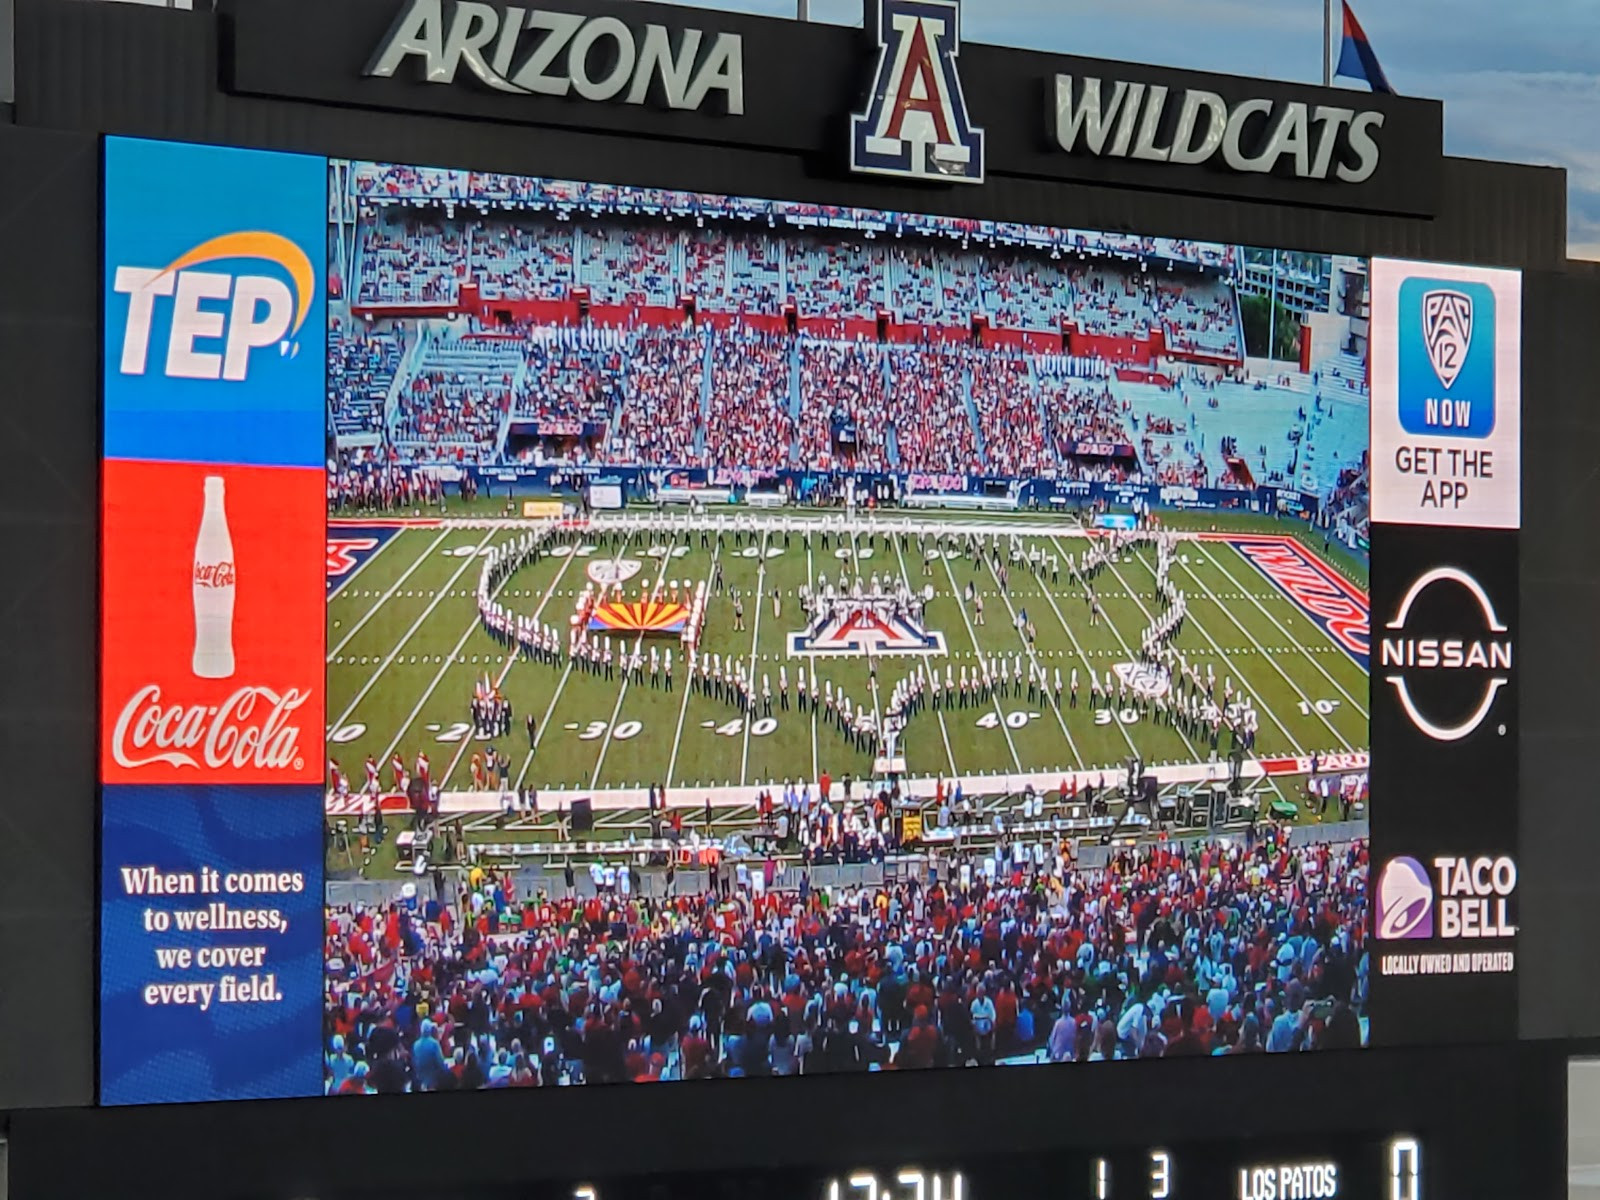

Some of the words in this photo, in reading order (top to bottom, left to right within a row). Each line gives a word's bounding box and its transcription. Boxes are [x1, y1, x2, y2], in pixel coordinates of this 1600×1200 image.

[360, 0, 745, 116] ARIZONA
[850, 0, 985, 184] A
[1055, 74, 1385, 183] WILDCATS
[114, 265, 293, 382] TEP
[1425, 293, 1472, 346] PAC
[1438, 342, 1457, 369] 12
[1426, 398, 1471, 428] NOW
[1395, 446, 1443, 475] GET
[1447, 449, 1493, 479] THE
[1420, 479, 1468, 509] APP
[1382, 638, 1512, 669] NISSAN
[112, 684, 313, 770] Coca-Cola
[121, 867, 195, 895] When
[201, 866, 219, 893] it
[225, 872, 304, 892] comes
[1434, 857, 1517, 896] TACO
[144, 908, 169, 931] to
[173, 903, 288, 933] wellness,
[1441, 899, 1516, 938] BELL
[156, 949, 191, 969] we
[198, 946, 266, 967] cover
[1382, 955, 1419, 975] LOCALLY
[1420, 954, 1450, 974] OWNED
[1452, 953, 1470, 973] AND
[1471, 952, 1514, 973] OPERATED
[145, 982, 214, 1010] every
[219, 974, 283, 1003] field.
[1151, 1153, 1169, 1199] 3
[1240, 1168, 1277, 1200] LOS
[1280, 1164, 1337, 1199] PATOS
